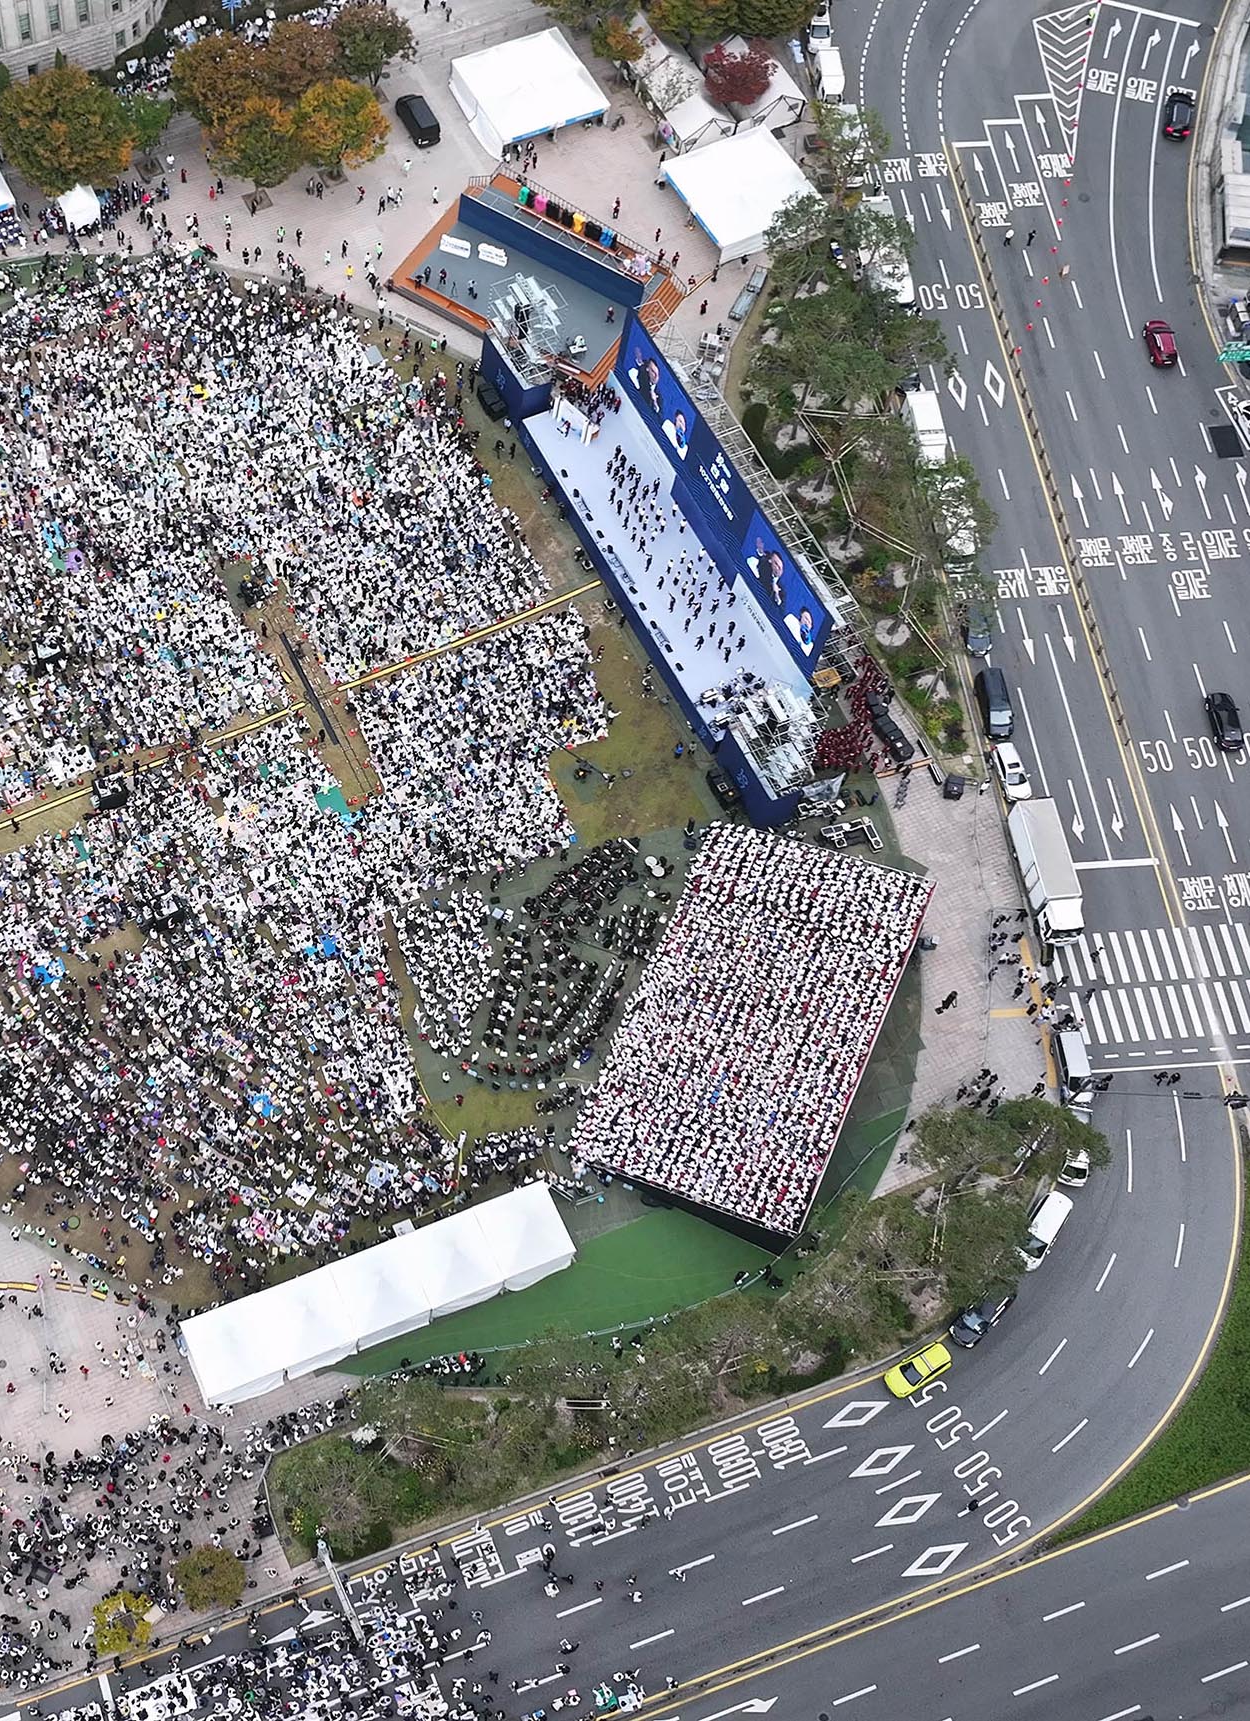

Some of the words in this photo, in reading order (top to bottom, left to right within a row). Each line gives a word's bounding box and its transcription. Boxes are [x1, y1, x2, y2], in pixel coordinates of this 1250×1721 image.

[1086, 68, 1118, 94] 을지로
[1125, 77, 1158, 103] 을지로
[1008, 182, 1044, 207] 광화문
[976, 202, 1012, 227] 광화문
[919, 284, 948, 310] 50
[957, 282, 984, 310] 50
[1076, 536, 1115, 568] 광화문
[1117, 535, 1158, 564] 광화문
[1201, 529, 1241, 560] 을지로
[1171, 569, 1212, 600] 을지로
[1139, 739, 1174, 773] 50
[1182, 736, 1218, 770] 50
[1178, 876, 1220, 910] 광화문
[1223, 872, 1250, 907] 청계
[756, 1415, 812, 1471] 18:00
[924, 1404, 974, 1451] 50
[706, 1433, 762, 1490] 10:00
[954, 1450, 1002, 1497] 50
[654, 1451, 711, 1511] 토요일
[605, 1471, 661, 1529] 14:00
[550, 1489, 607, 1548] 11:00
[982, 1499, 1032, 1547] 50
